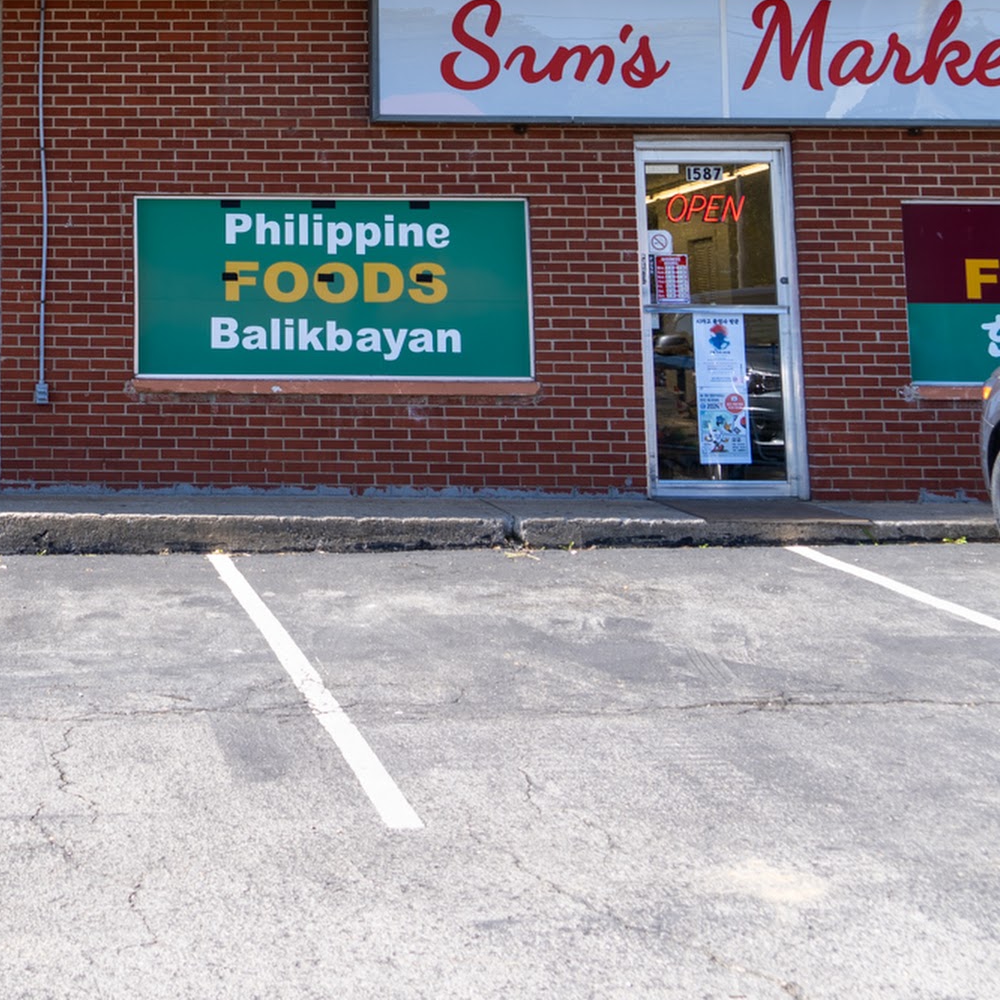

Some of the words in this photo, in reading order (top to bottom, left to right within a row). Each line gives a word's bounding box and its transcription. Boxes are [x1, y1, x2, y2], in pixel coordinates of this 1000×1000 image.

[687, 167, 721, 180] 1587
[666, 193, 745, 222] OPEN
[224, 213, 450, 255] Philippine
[224, 261, 448, 304] FOODS
[210, 317, 462, 361] Balikbayan
